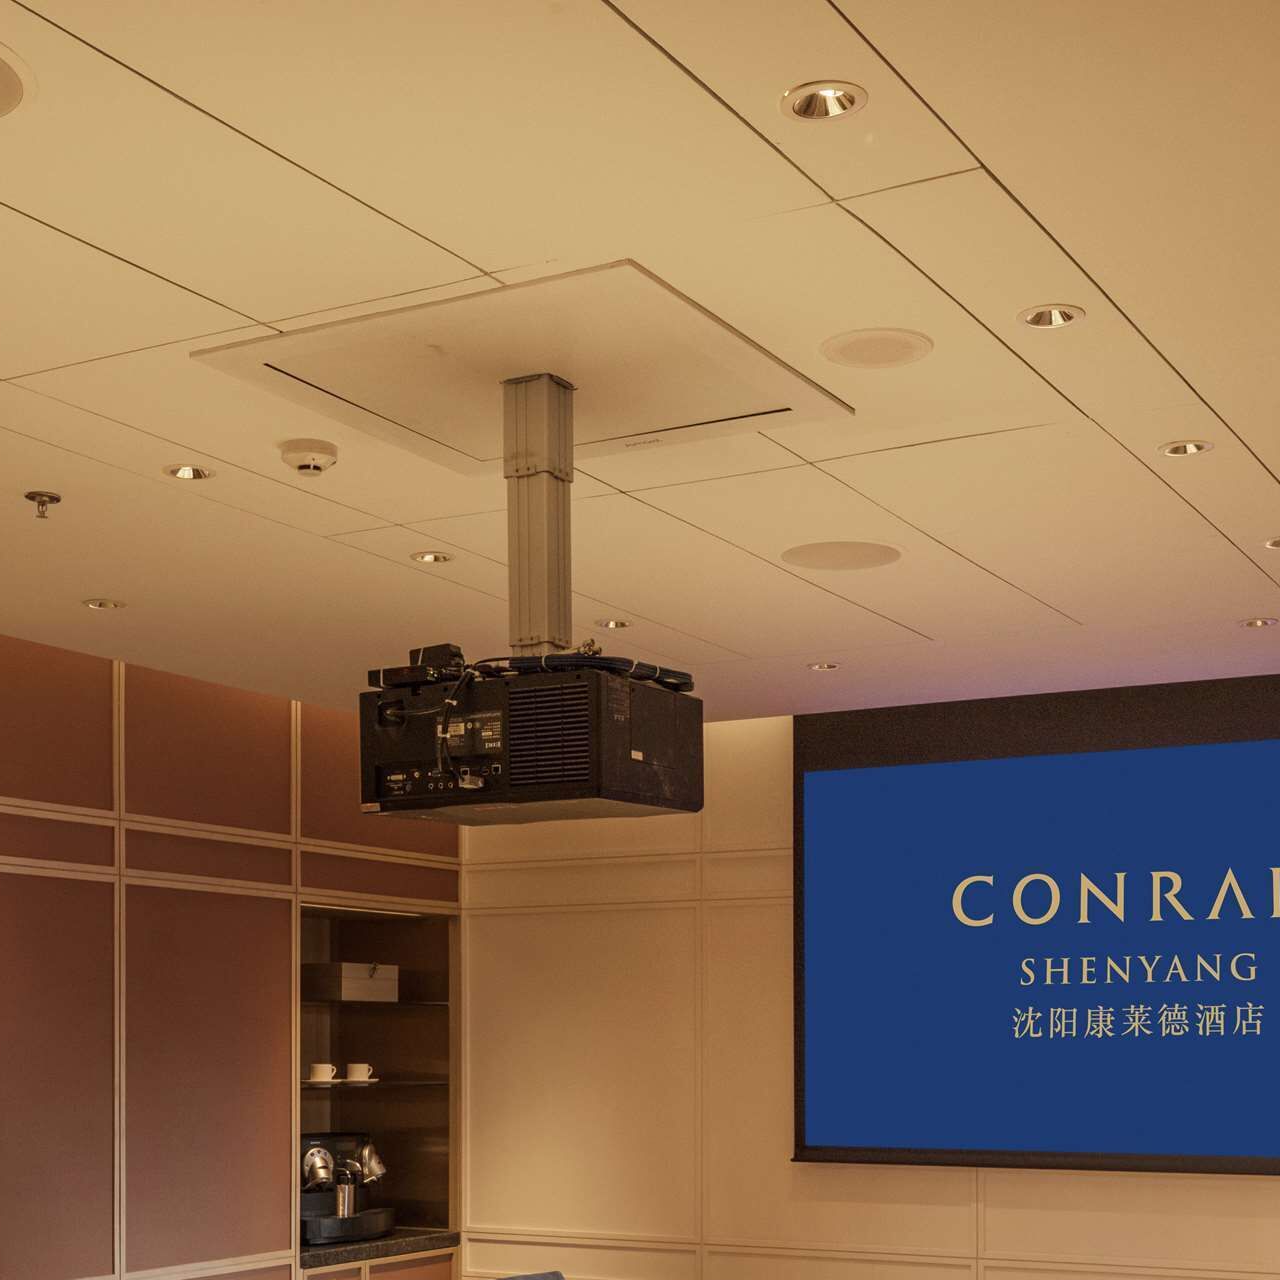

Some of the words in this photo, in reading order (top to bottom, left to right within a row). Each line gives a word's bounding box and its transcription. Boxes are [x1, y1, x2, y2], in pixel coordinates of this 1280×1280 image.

[1019, 952, 1259, 987] SHENYANG
[1012, 1001, 1265, 1040] 沈阳康莱德酒店
